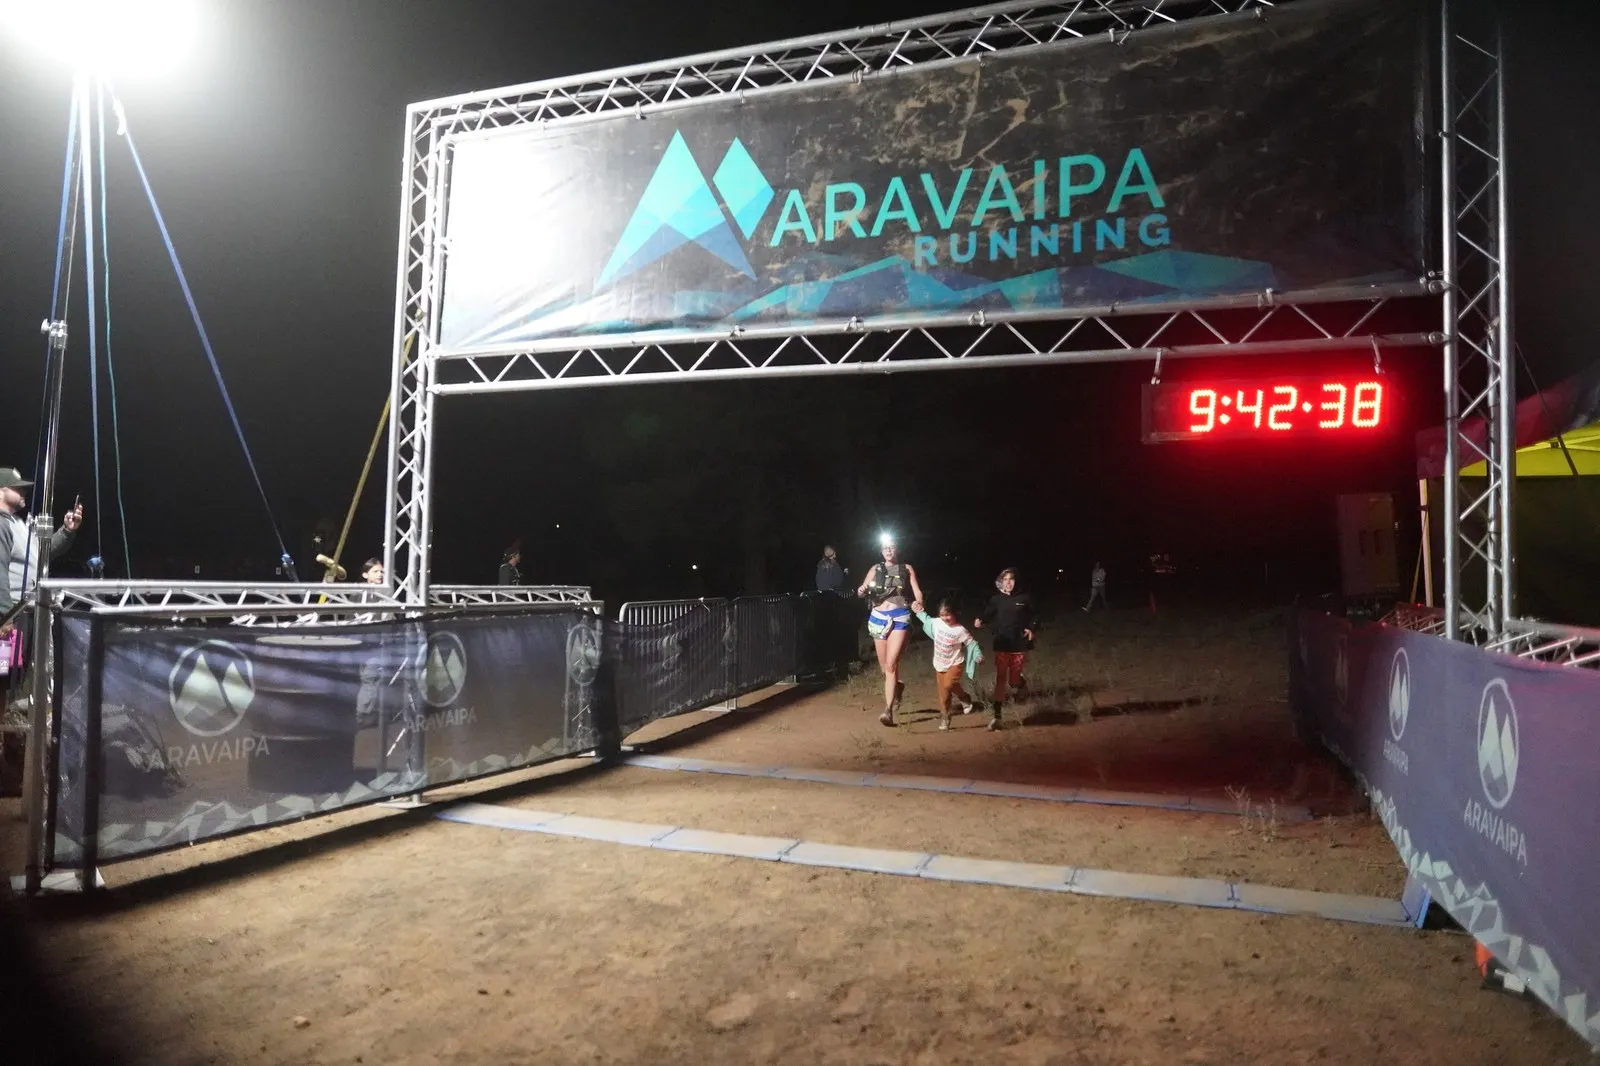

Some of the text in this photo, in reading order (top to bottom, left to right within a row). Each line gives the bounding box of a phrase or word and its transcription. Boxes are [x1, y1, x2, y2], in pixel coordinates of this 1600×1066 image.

[769, 147, 1166, 248] ARAVAIPA
[913, 213, 1172, 268] RUNNING
[406, 706, 478, 733] ARAVAIPA
[146, 735, 271, 772] ARAVAIPA
[1463, 797, 1528, 867] ARAVAIPA
